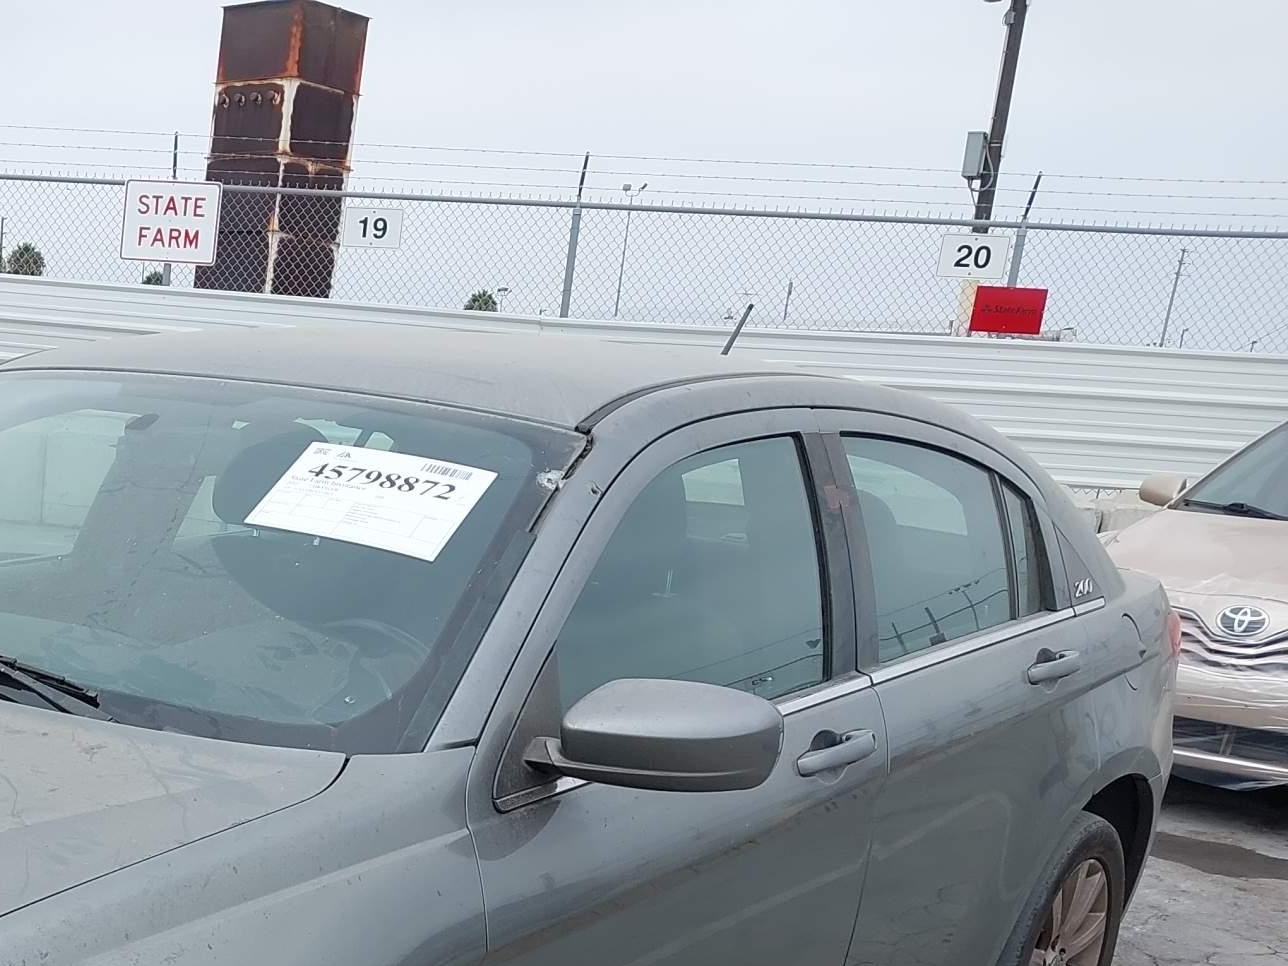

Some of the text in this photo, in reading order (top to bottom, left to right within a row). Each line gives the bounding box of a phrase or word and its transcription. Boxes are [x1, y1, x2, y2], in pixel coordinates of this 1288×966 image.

[137, 194, 207, 218] STATE
[137, 226, 199, 249] FARM
[359, 216, 388, 239] 19
[953, 244, 992, 269] 20
[308, 463, 456, 500] 45798872
